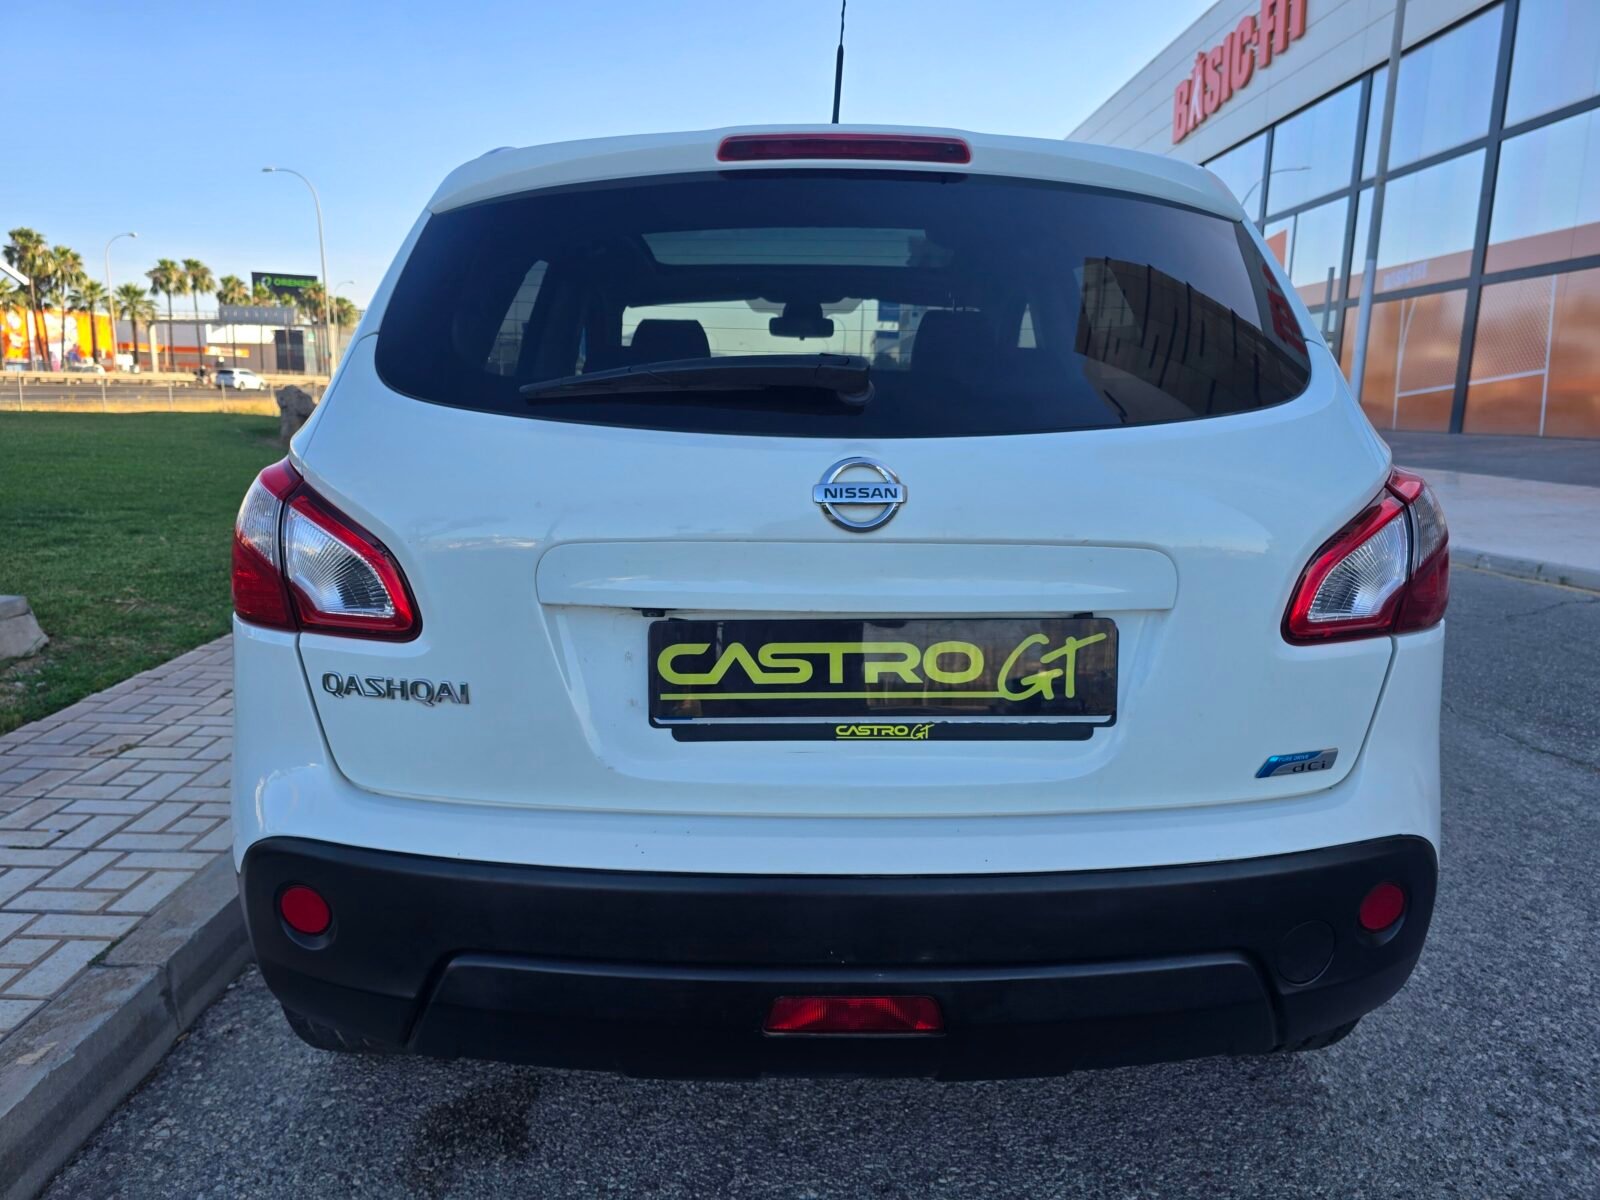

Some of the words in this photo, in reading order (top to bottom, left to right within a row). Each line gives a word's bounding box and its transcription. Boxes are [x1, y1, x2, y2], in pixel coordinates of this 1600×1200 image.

[824, 487, 898, 499] NISSAN
[657, 641, 984, 685] CASTRO
[997, 633, 1107, 701] GT
[322, 671, 470, 707] QASHQAI
[836, 725, 909, 736] CASTRO
[910, 724, 935, 740] GT
